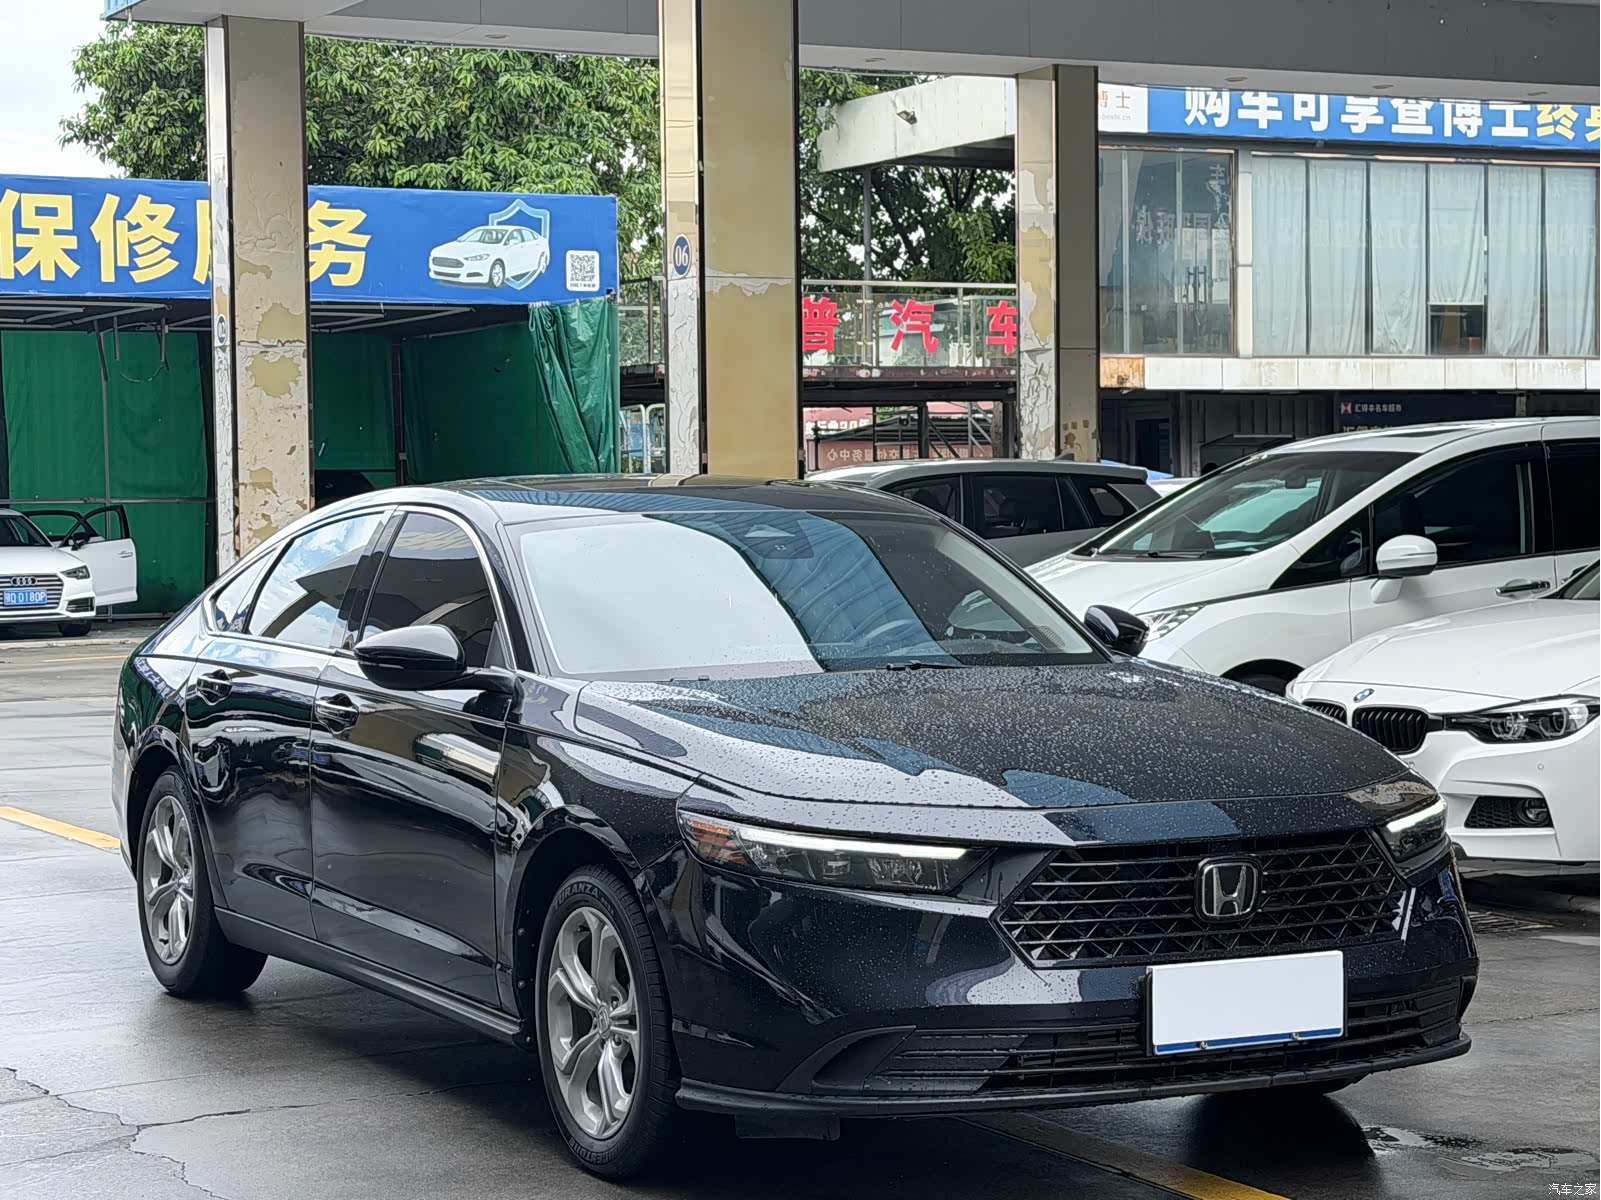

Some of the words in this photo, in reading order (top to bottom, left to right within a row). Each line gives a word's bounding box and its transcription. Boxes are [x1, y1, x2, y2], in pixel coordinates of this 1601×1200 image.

[0, 188, 372, 287] 保修务
[675, 244, 689, 267] 06
